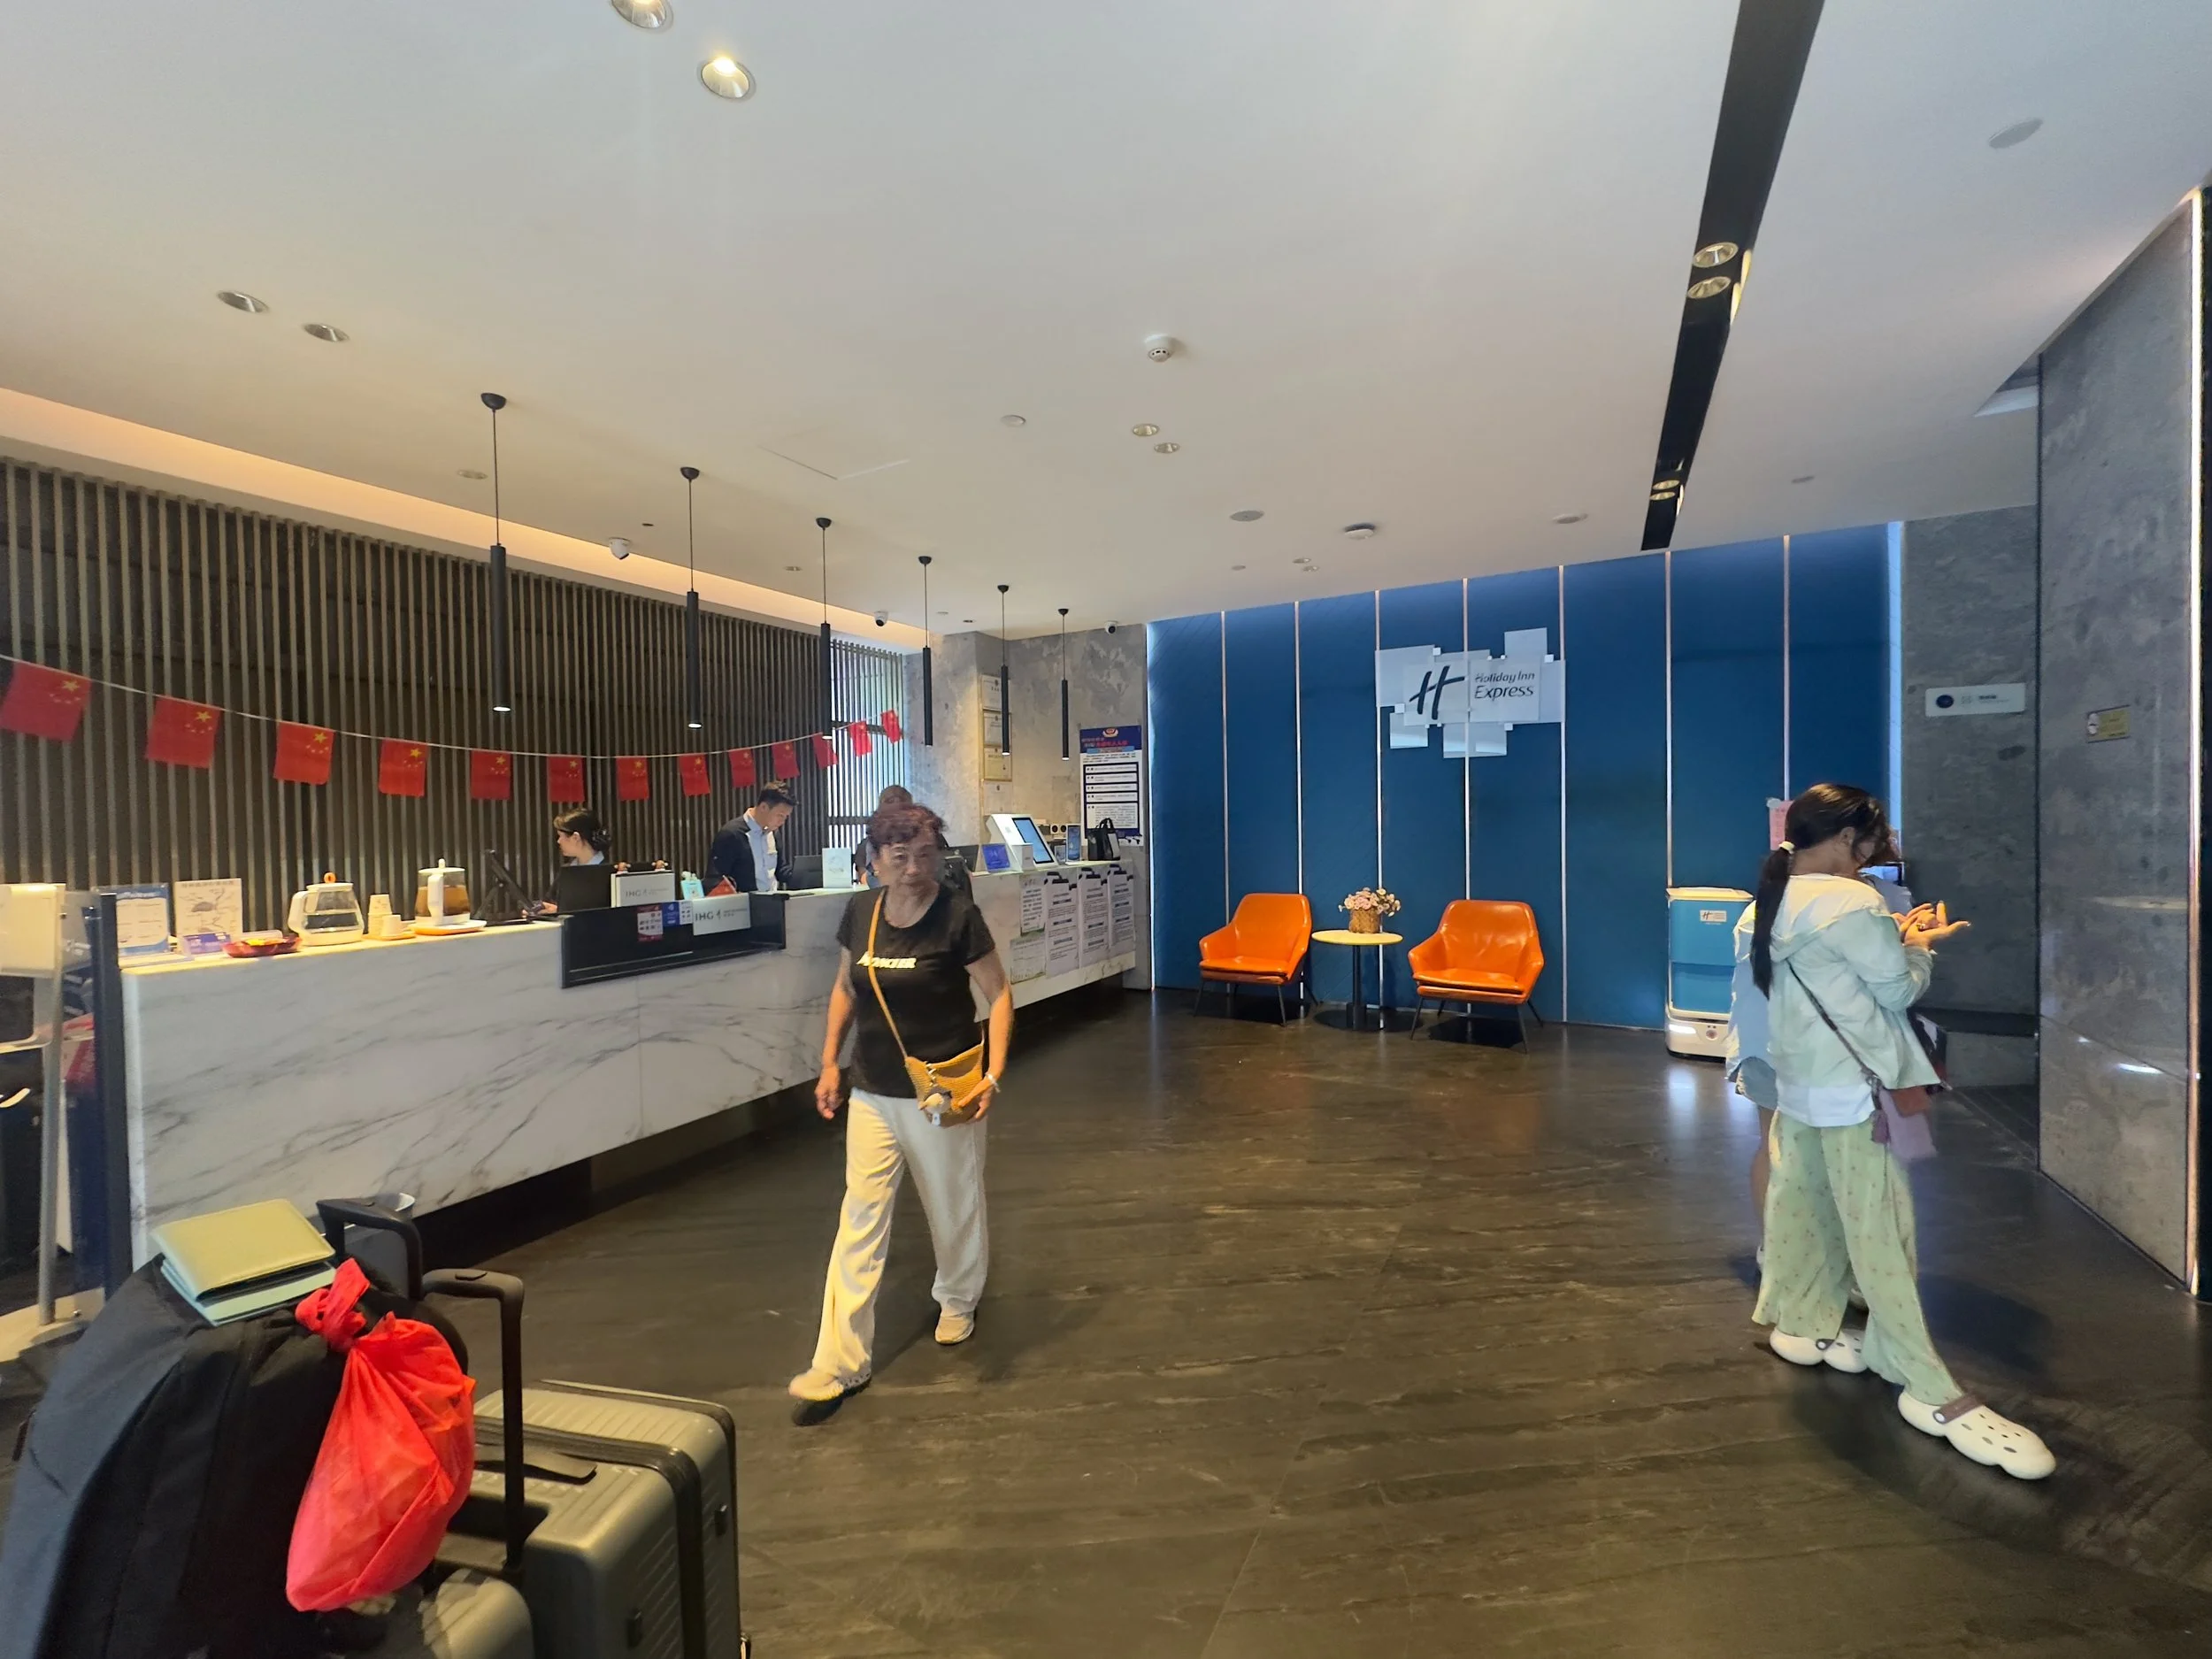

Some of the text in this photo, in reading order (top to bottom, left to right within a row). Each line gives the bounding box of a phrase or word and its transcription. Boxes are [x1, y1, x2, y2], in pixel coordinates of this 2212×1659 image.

[1475, 670, 1535, 683] Holiday Inn
[1474, 684, 1535, 701] Express
[695, 911, 714, 921] IHG
